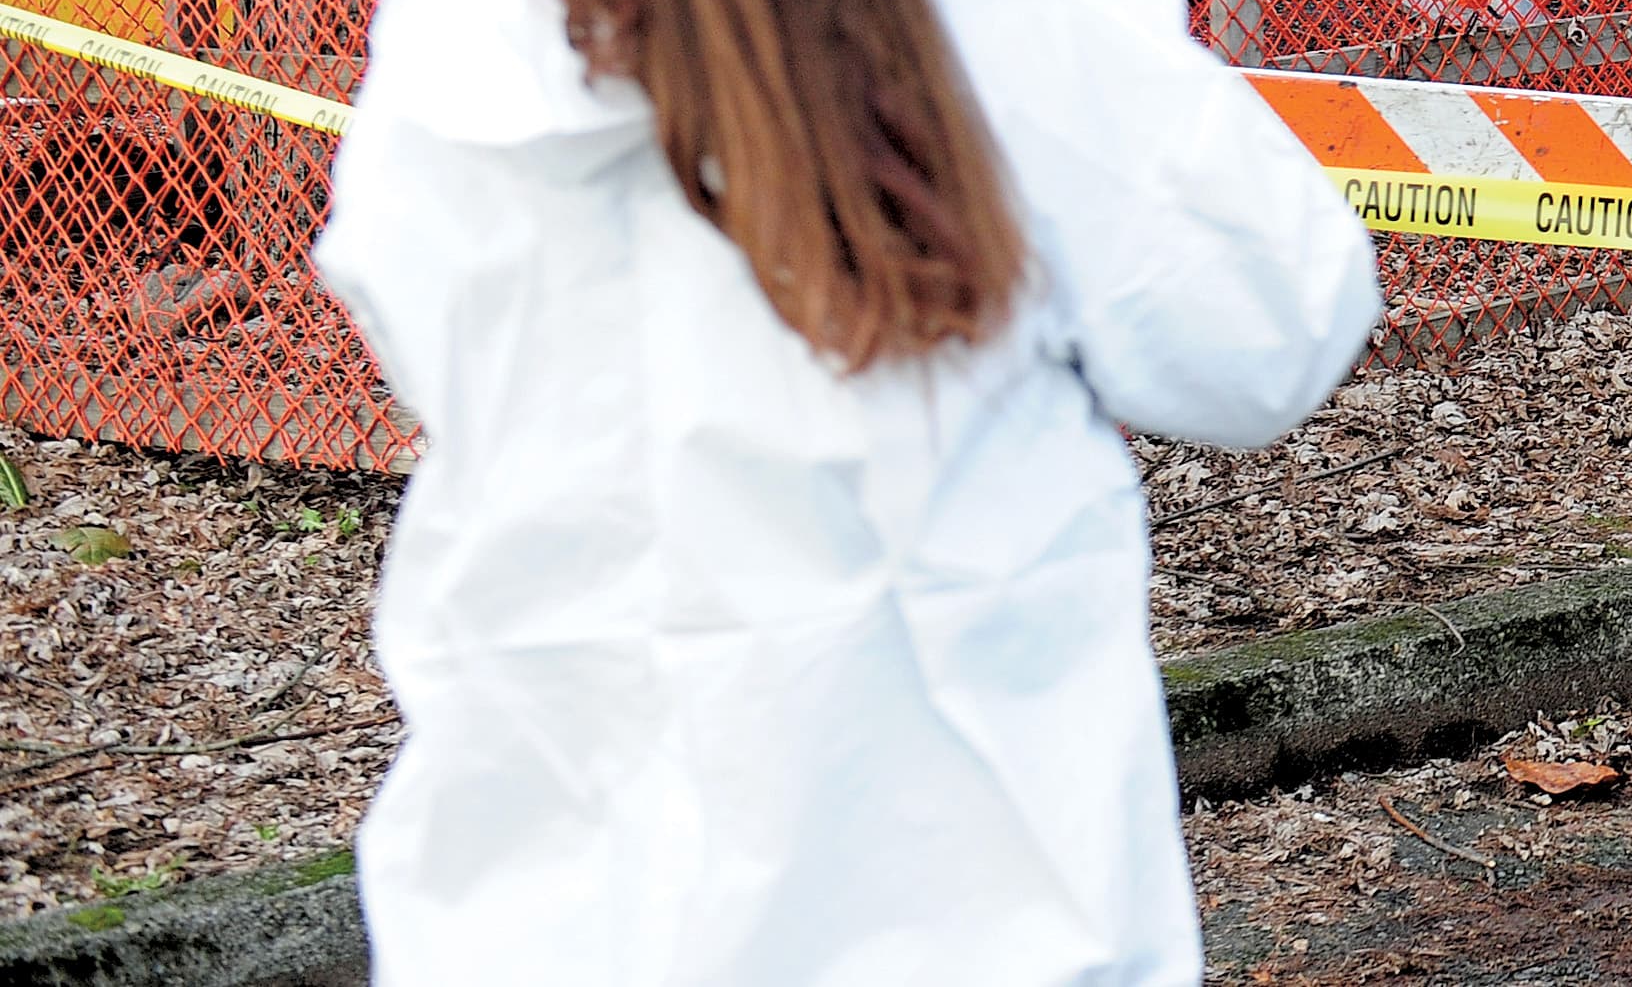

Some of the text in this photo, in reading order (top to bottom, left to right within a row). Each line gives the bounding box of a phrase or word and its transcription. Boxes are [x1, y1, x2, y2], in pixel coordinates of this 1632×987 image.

[79, 39, 162, 82] CAUTION
[191, 74, 279, 116] CAUTION
[1346, 179, 1477, 227] CAUTION
